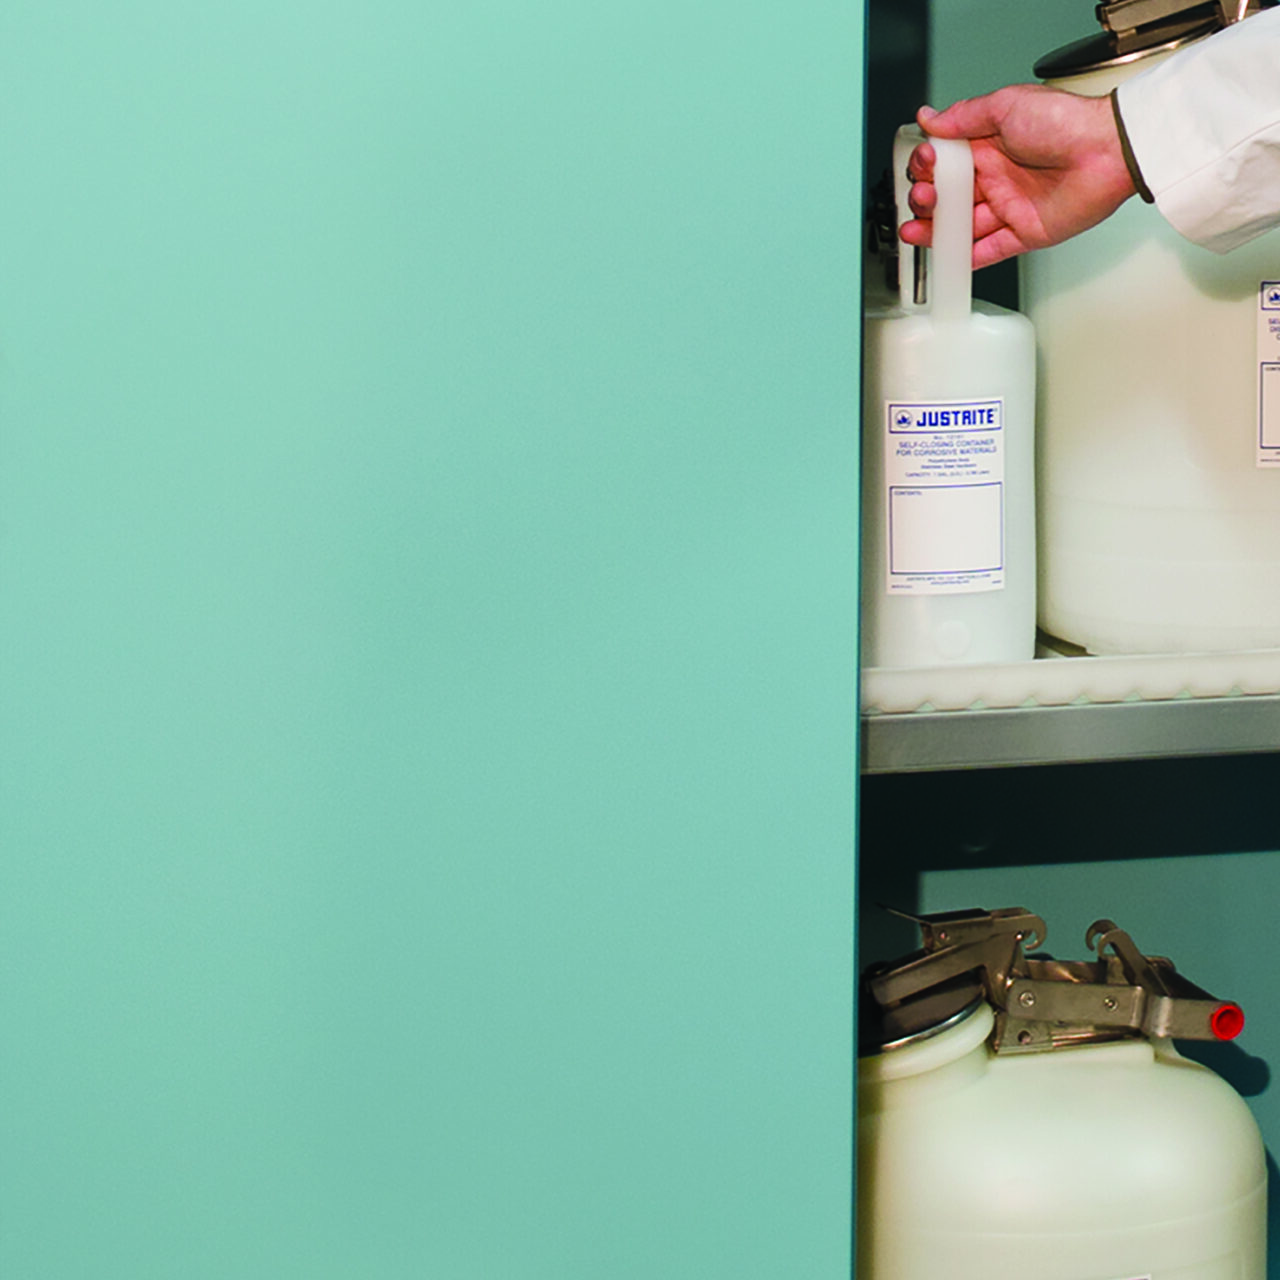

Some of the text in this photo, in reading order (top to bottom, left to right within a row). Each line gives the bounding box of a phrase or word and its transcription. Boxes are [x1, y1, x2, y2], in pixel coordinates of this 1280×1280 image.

[898, 438, 995, 449] SELF-CLOSING CONTAINER
[896, 449, 912, 457] FOR
[959, 446, 997, 455] MATERIALS
